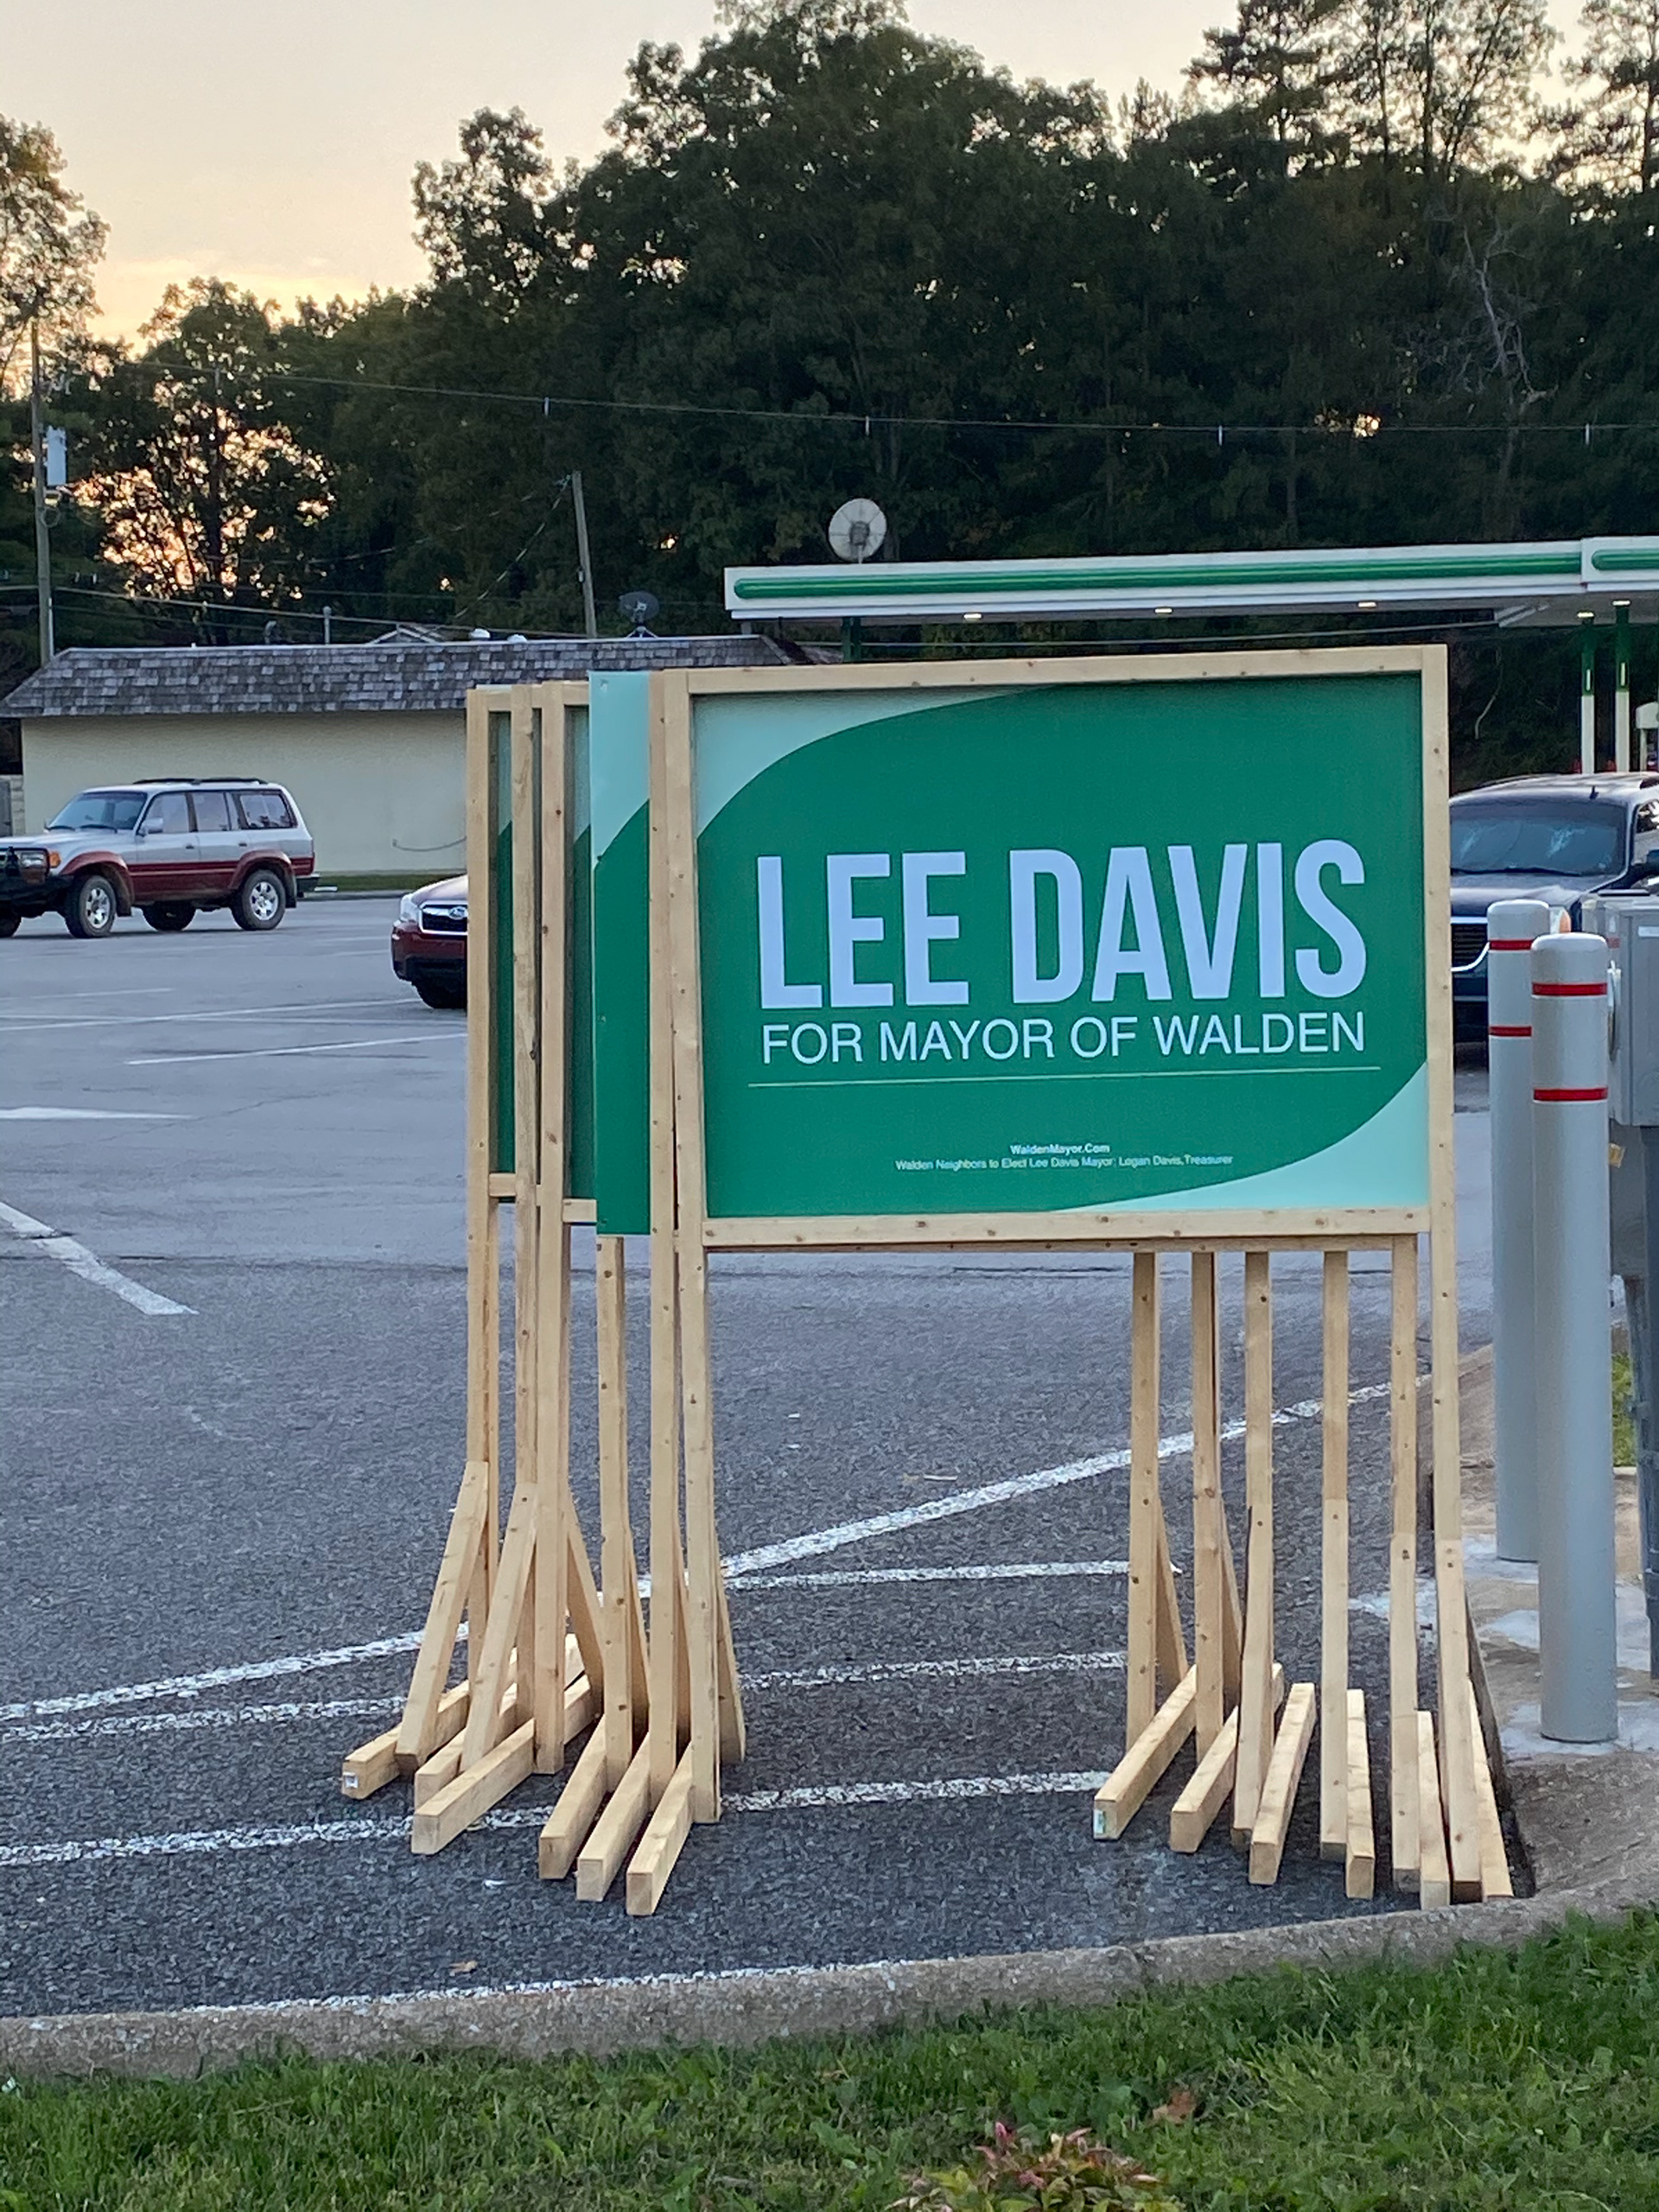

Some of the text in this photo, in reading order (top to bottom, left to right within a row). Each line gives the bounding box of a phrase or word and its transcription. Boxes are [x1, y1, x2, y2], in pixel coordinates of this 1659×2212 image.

[757, 839, 1367, 1009] LEE DAVIS
[763, 1011, 1364, 1065] FOR MAYOR OF WALDEN
[895, 1160, 934, 1171] Walden
[936, 1159, 987, 1172] Neighbors
[988, 1159, 999, 1168] to
[1001, 1157, 1028, 1168] Elect
[1029, 1158, 1048, 1168] Lee
[1051, 1157, 1079, 1167] Davis
[1119, 1156, 1151, 1168] Logan
[1009, 1143, 1110, 1156] WaldenMayor.Com
